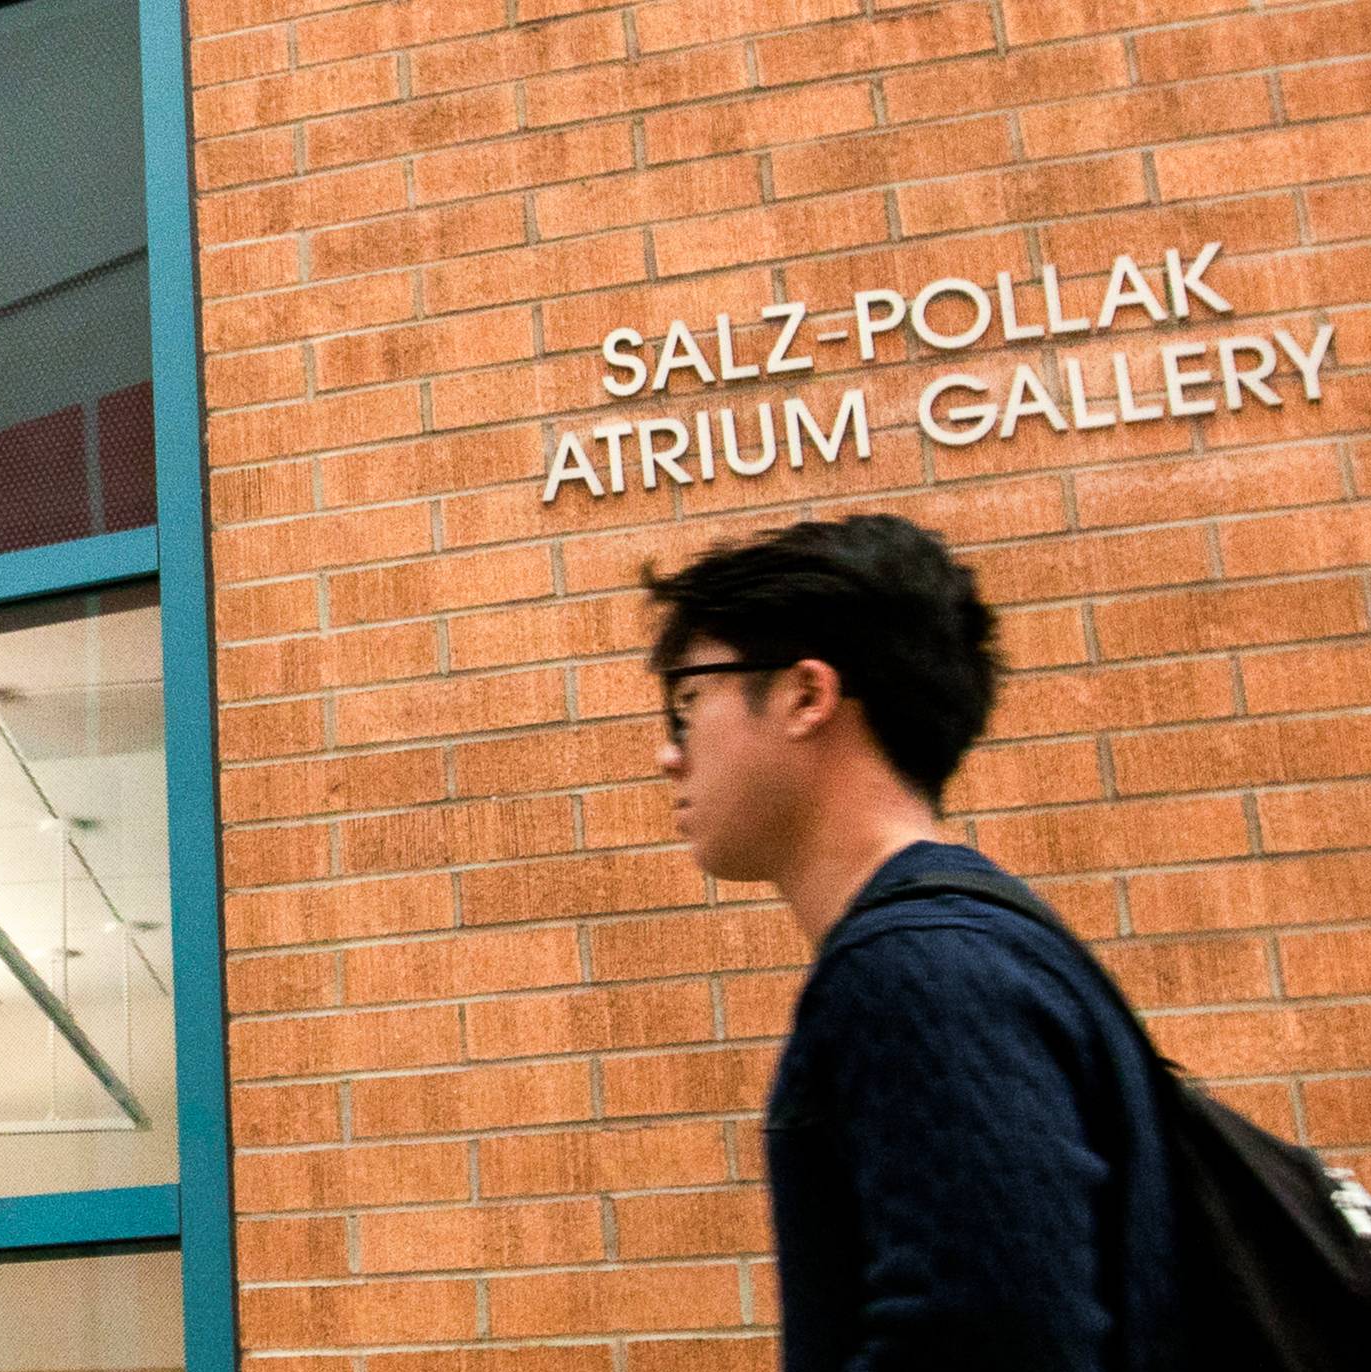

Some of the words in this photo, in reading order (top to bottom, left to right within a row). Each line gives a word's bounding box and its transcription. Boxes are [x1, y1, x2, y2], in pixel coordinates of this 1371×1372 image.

[601, 241, 1232, 397] SALZ-POLLAK
[542, 388, 871, 503] ATRIUM
[918, 325, 1336, 447] GALLERY
